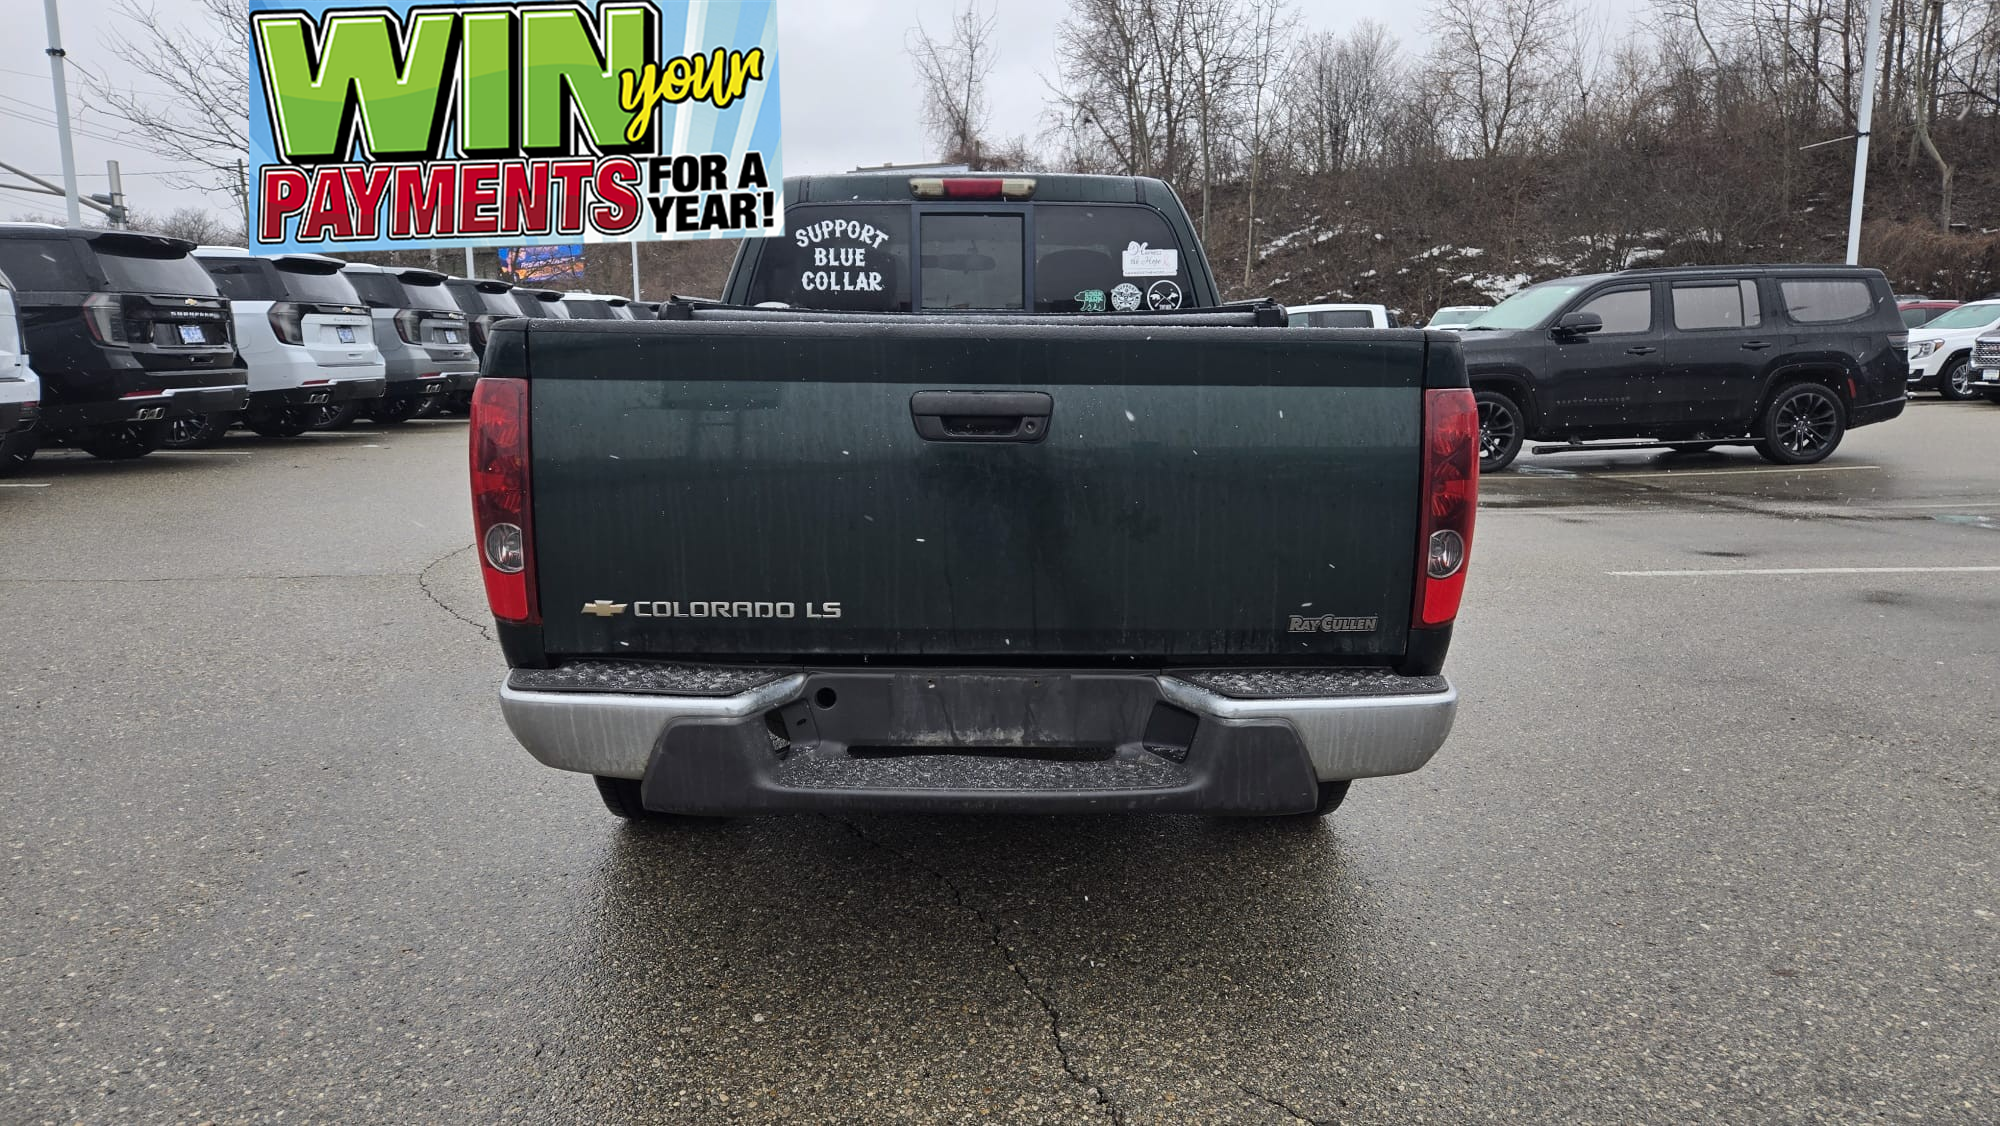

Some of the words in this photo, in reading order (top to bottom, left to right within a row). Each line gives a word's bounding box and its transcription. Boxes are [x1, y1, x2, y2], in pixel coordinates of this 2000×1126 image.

[795, 218, 890, 249] SUPPORT
[814, 247, 866, 267] BLUE
[801, 270, 883, 291] COLLAR
[633, 601, 795, 618] COLORADO
[806, 602, 842, 618] LS
